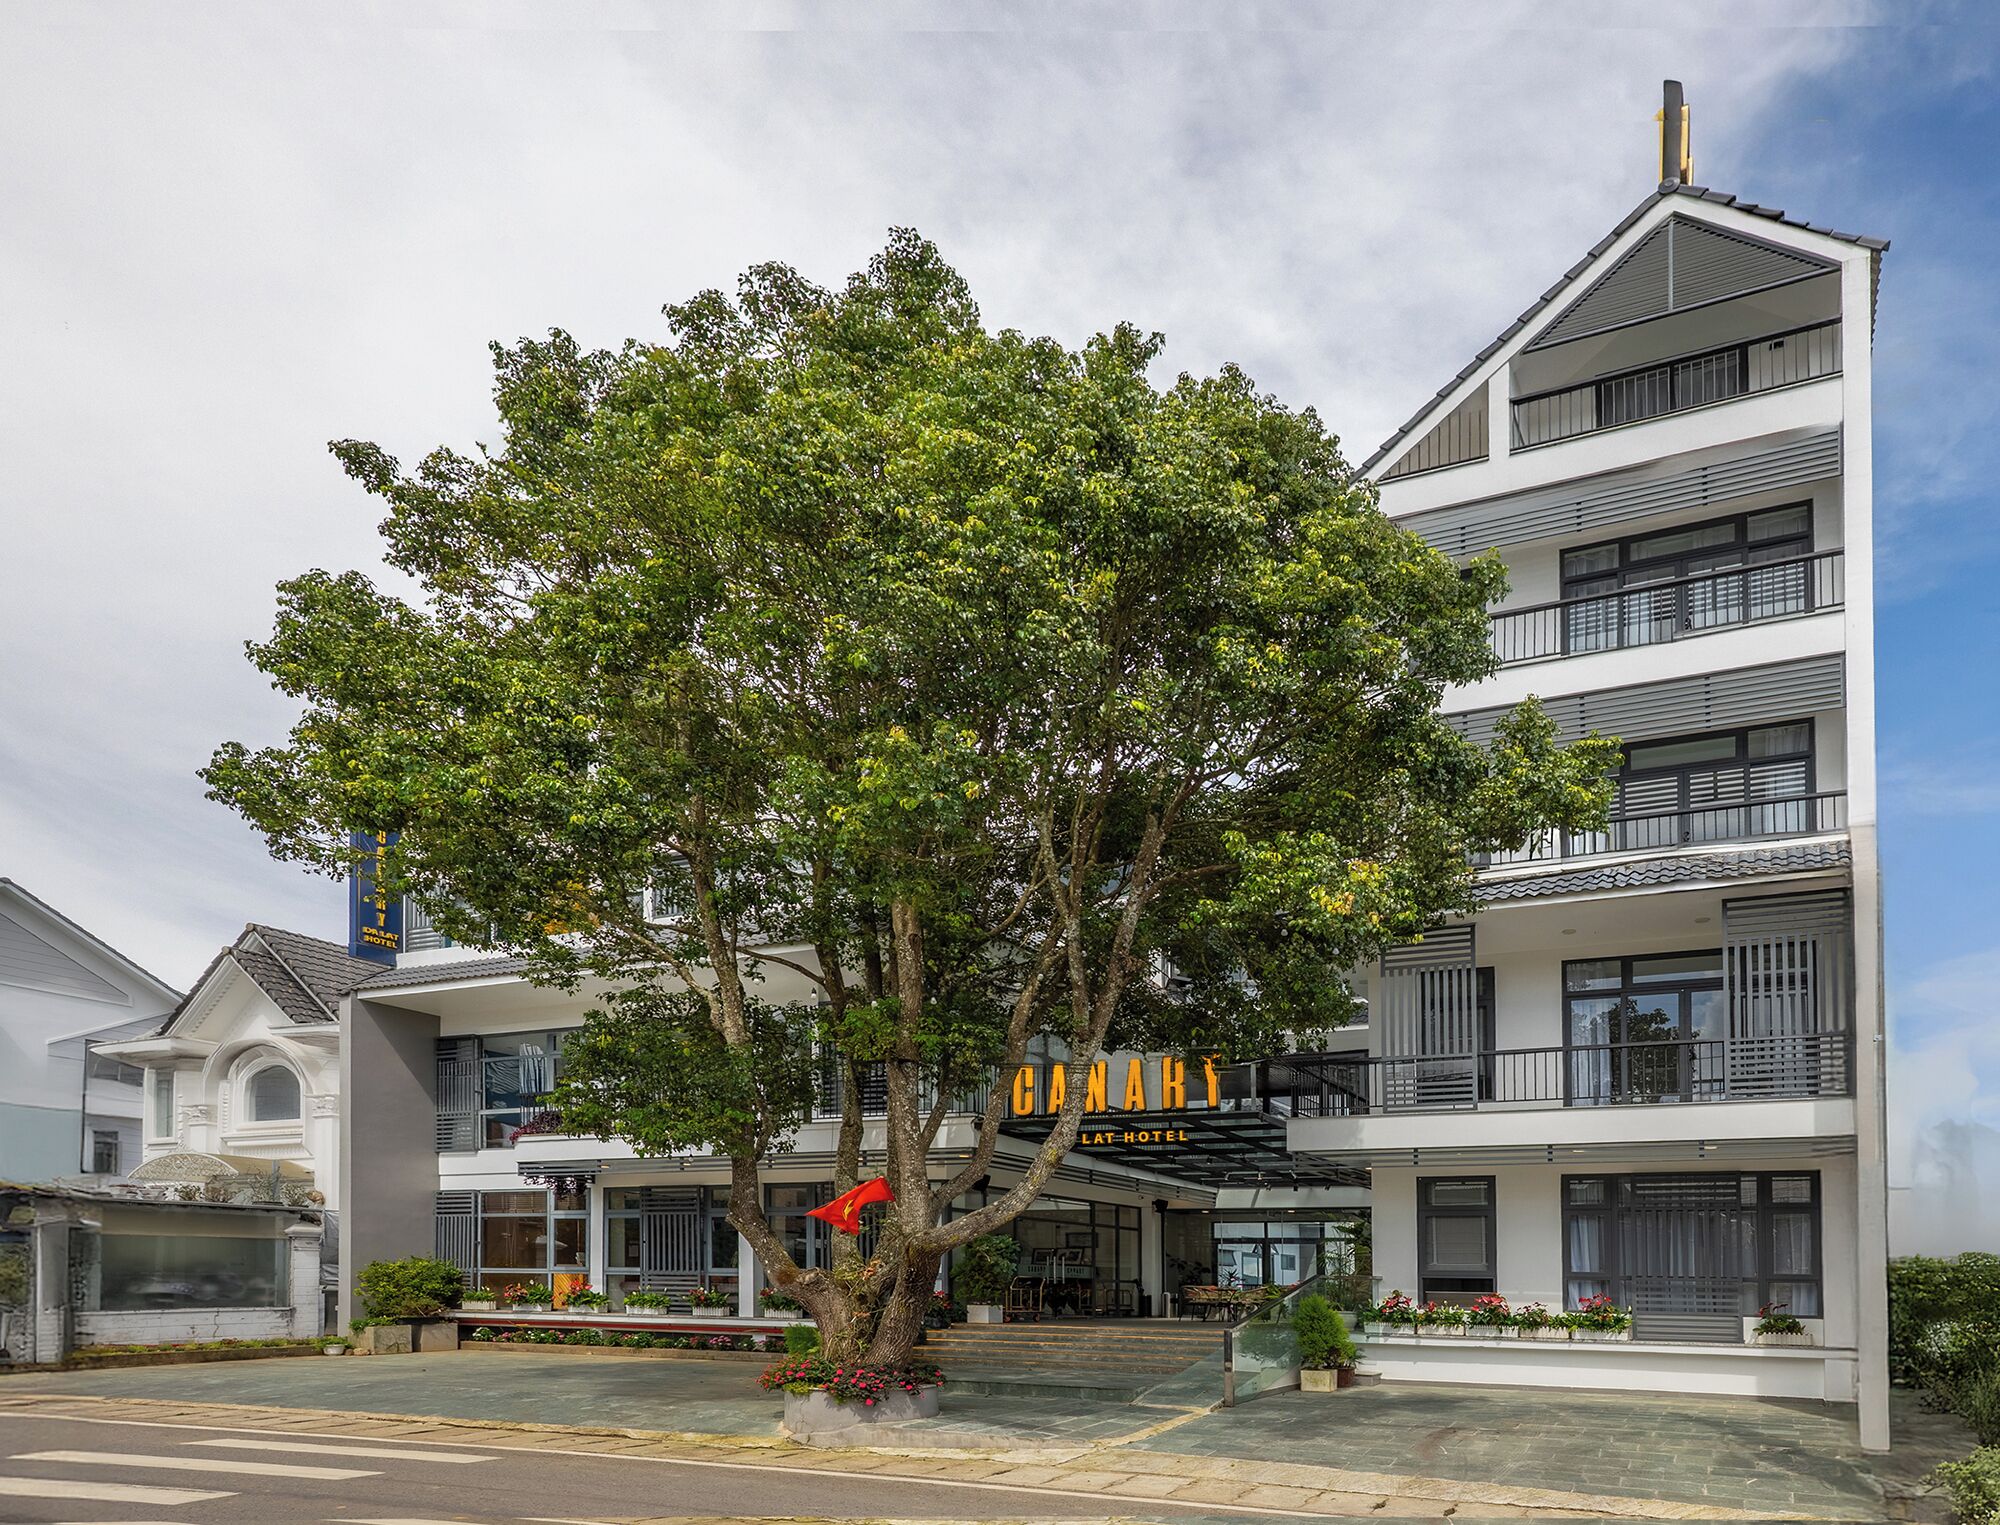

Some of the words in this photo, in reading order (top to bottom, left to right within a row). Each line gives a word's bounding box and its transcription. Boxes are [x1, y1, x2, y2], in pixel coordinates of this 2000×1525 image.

[364, 935, 398, 949] HOTEL
[1013, 1053, 1222, 1115] CANARY
[1082, 1132, 1114, 1144] LAT
[1124, 1130, 1188, 1143] HOTEL
